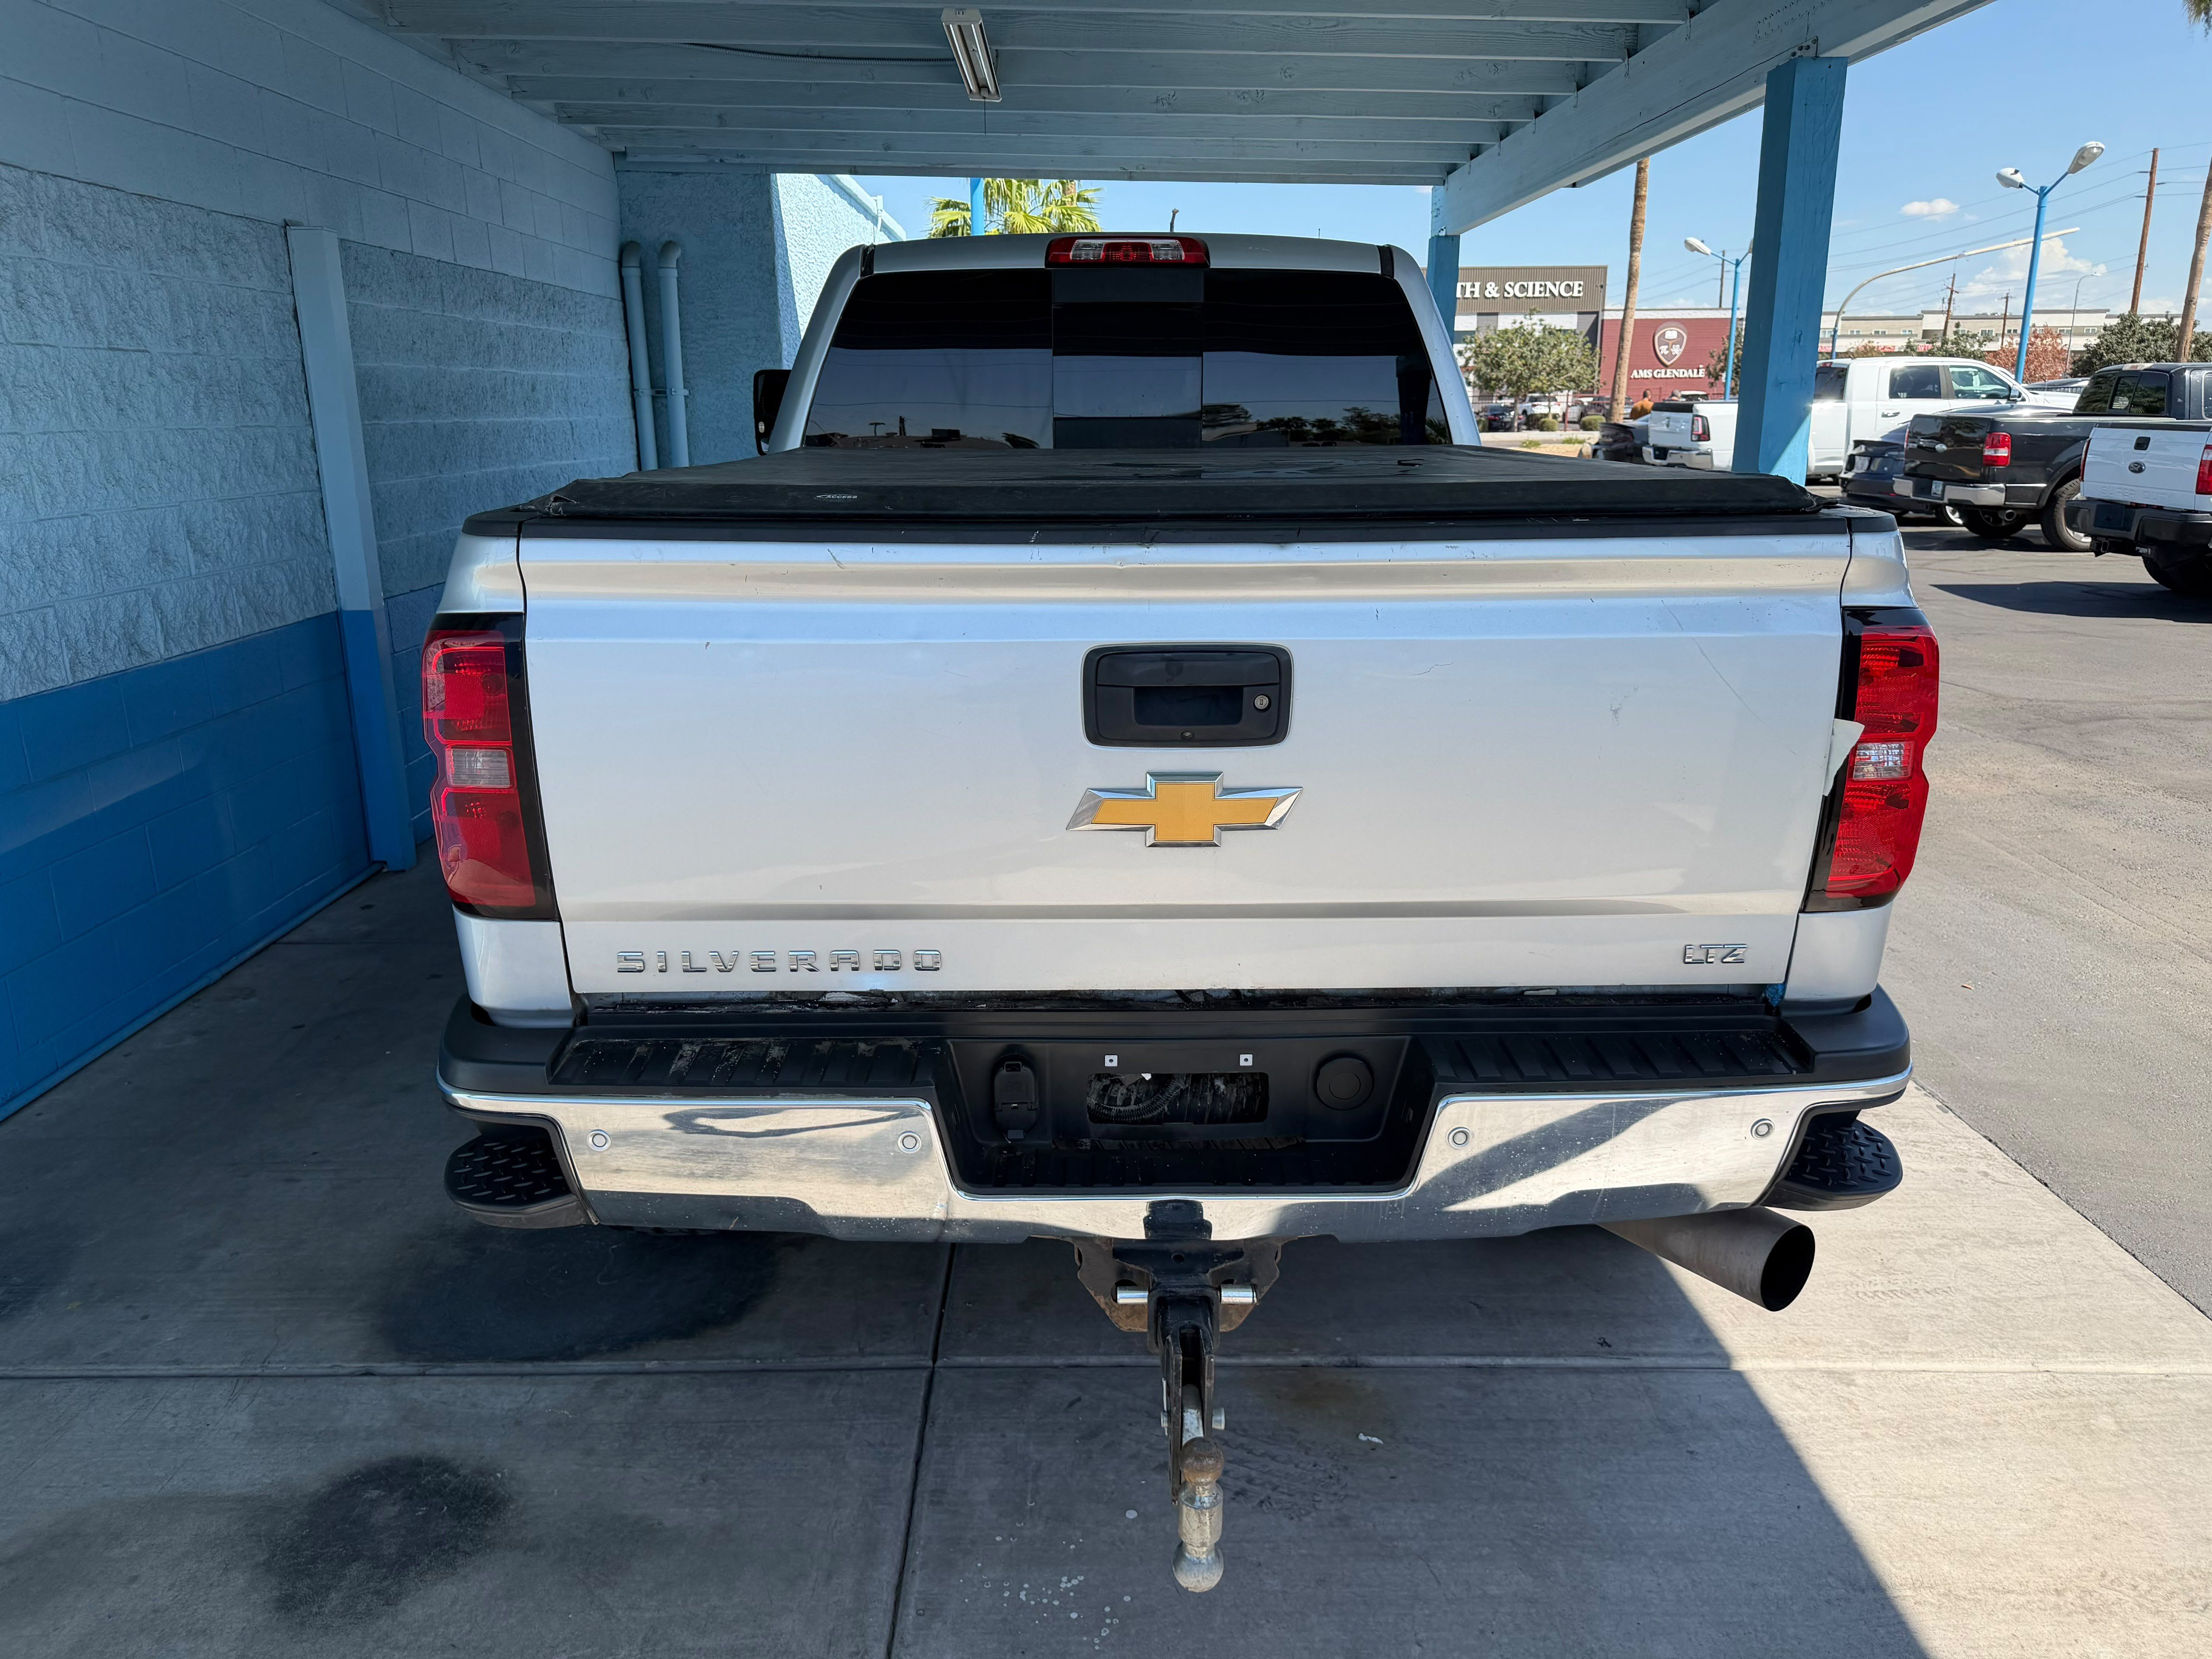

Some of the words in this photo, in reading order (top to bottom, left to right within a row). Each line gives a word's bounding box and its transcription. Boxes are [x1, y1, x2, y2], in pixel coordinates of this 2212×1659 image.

[1484, 281, 1500, 298] &
[1504, 281, 1584, 298] SCIENCE
[1630, 369, 1653, 378] AMS
[1653, 369, 1706, 378] GLENDALE
[616, 950, 942, 973] SILVERADO
[1683, 944, 1748, 964] LTZ
